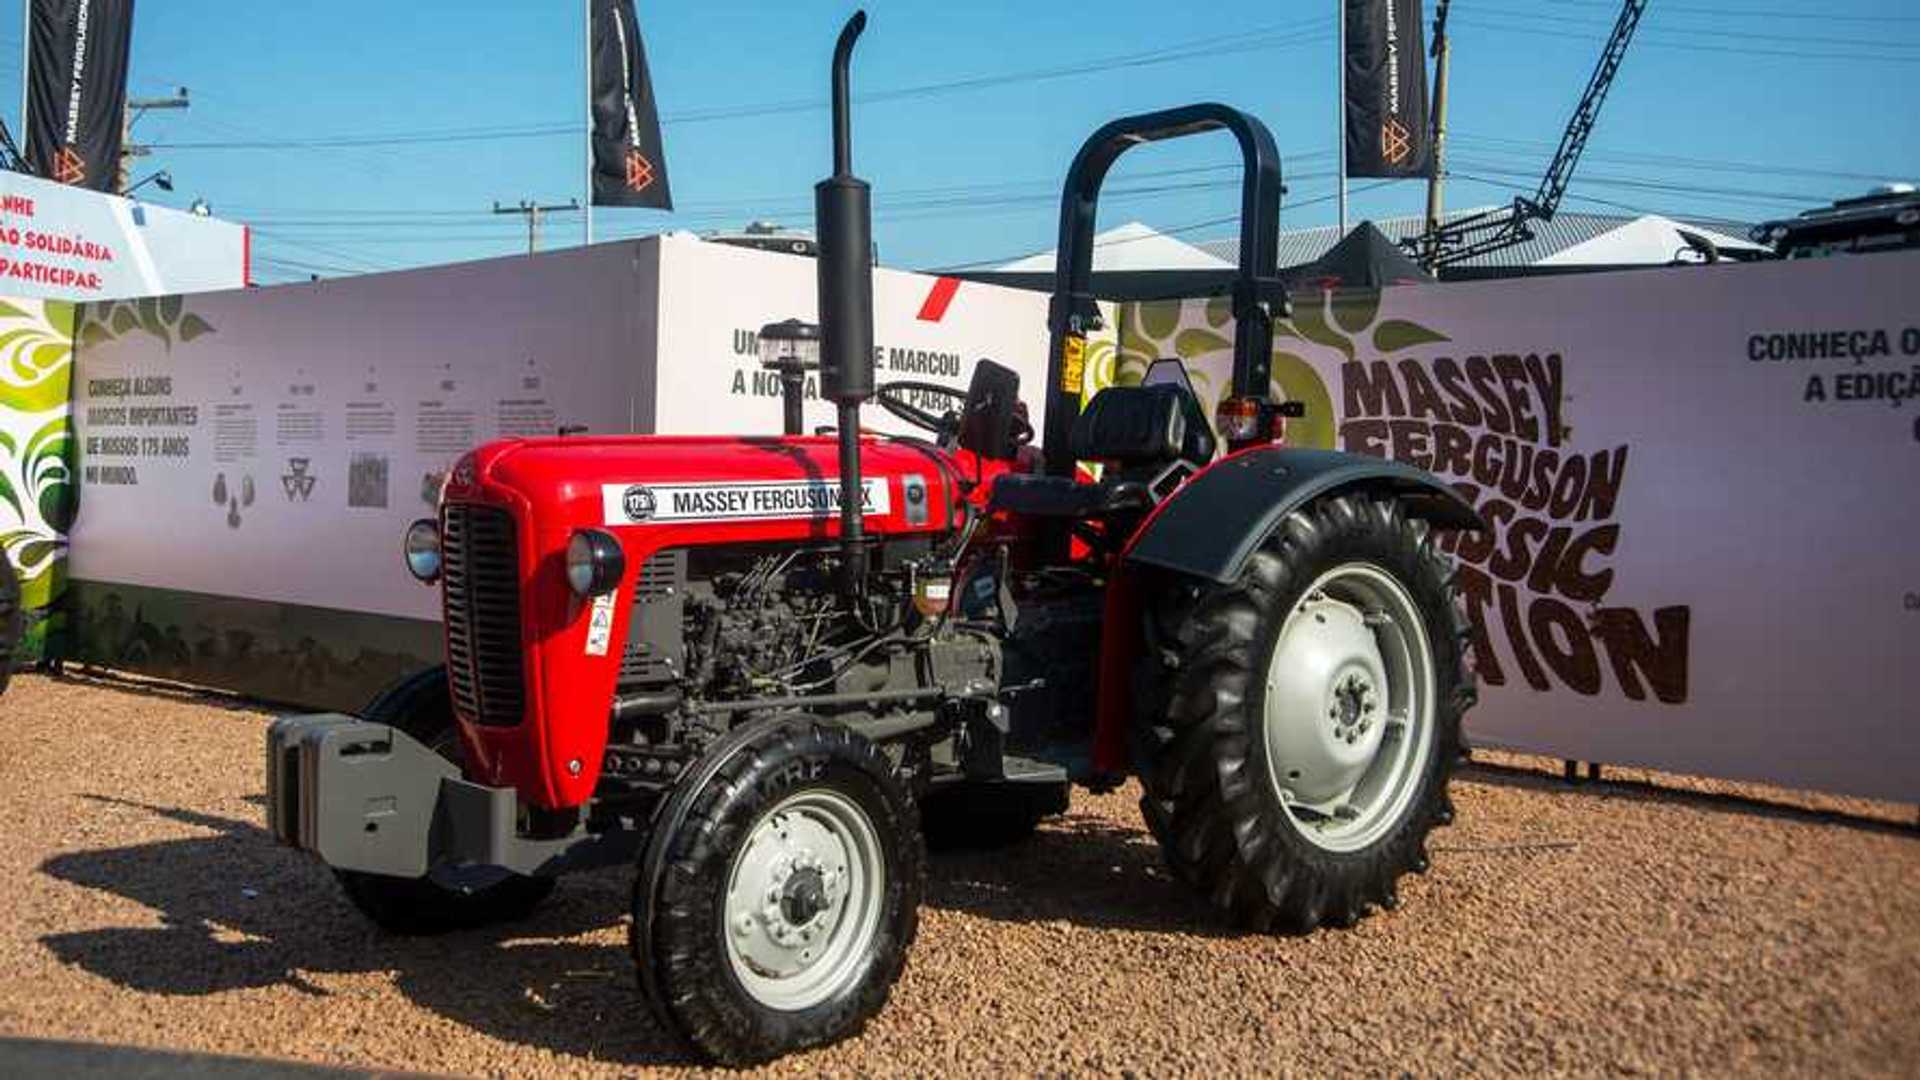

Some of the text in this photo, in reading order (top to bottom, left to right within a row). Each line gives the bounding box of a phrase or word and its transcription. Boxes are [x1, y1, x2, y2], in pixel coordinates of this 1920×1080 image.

[66, 80, 82, 144] MASSEY
[25, 231, 112, 262] SOLIDÁRIA
[0, 259, 102, 290] PARTICIPAR:
[890, 348, 960, 377] MARCOU
[1747, 329, 1891, 364] CONHEÇA
[732, 369, 746, 395] A
[753, 371, 817, 401] NOA
[1341, 353, 1562, 448] MASSEY
[1804, 374, 1827, 402] A
[1340, 418, 1629, 522] FERGUSON
[673, 491, 748, 513] MASSEY
[753, 486, 842, 511] FERGUSON
[1455, 562, 1690, 705] TION
